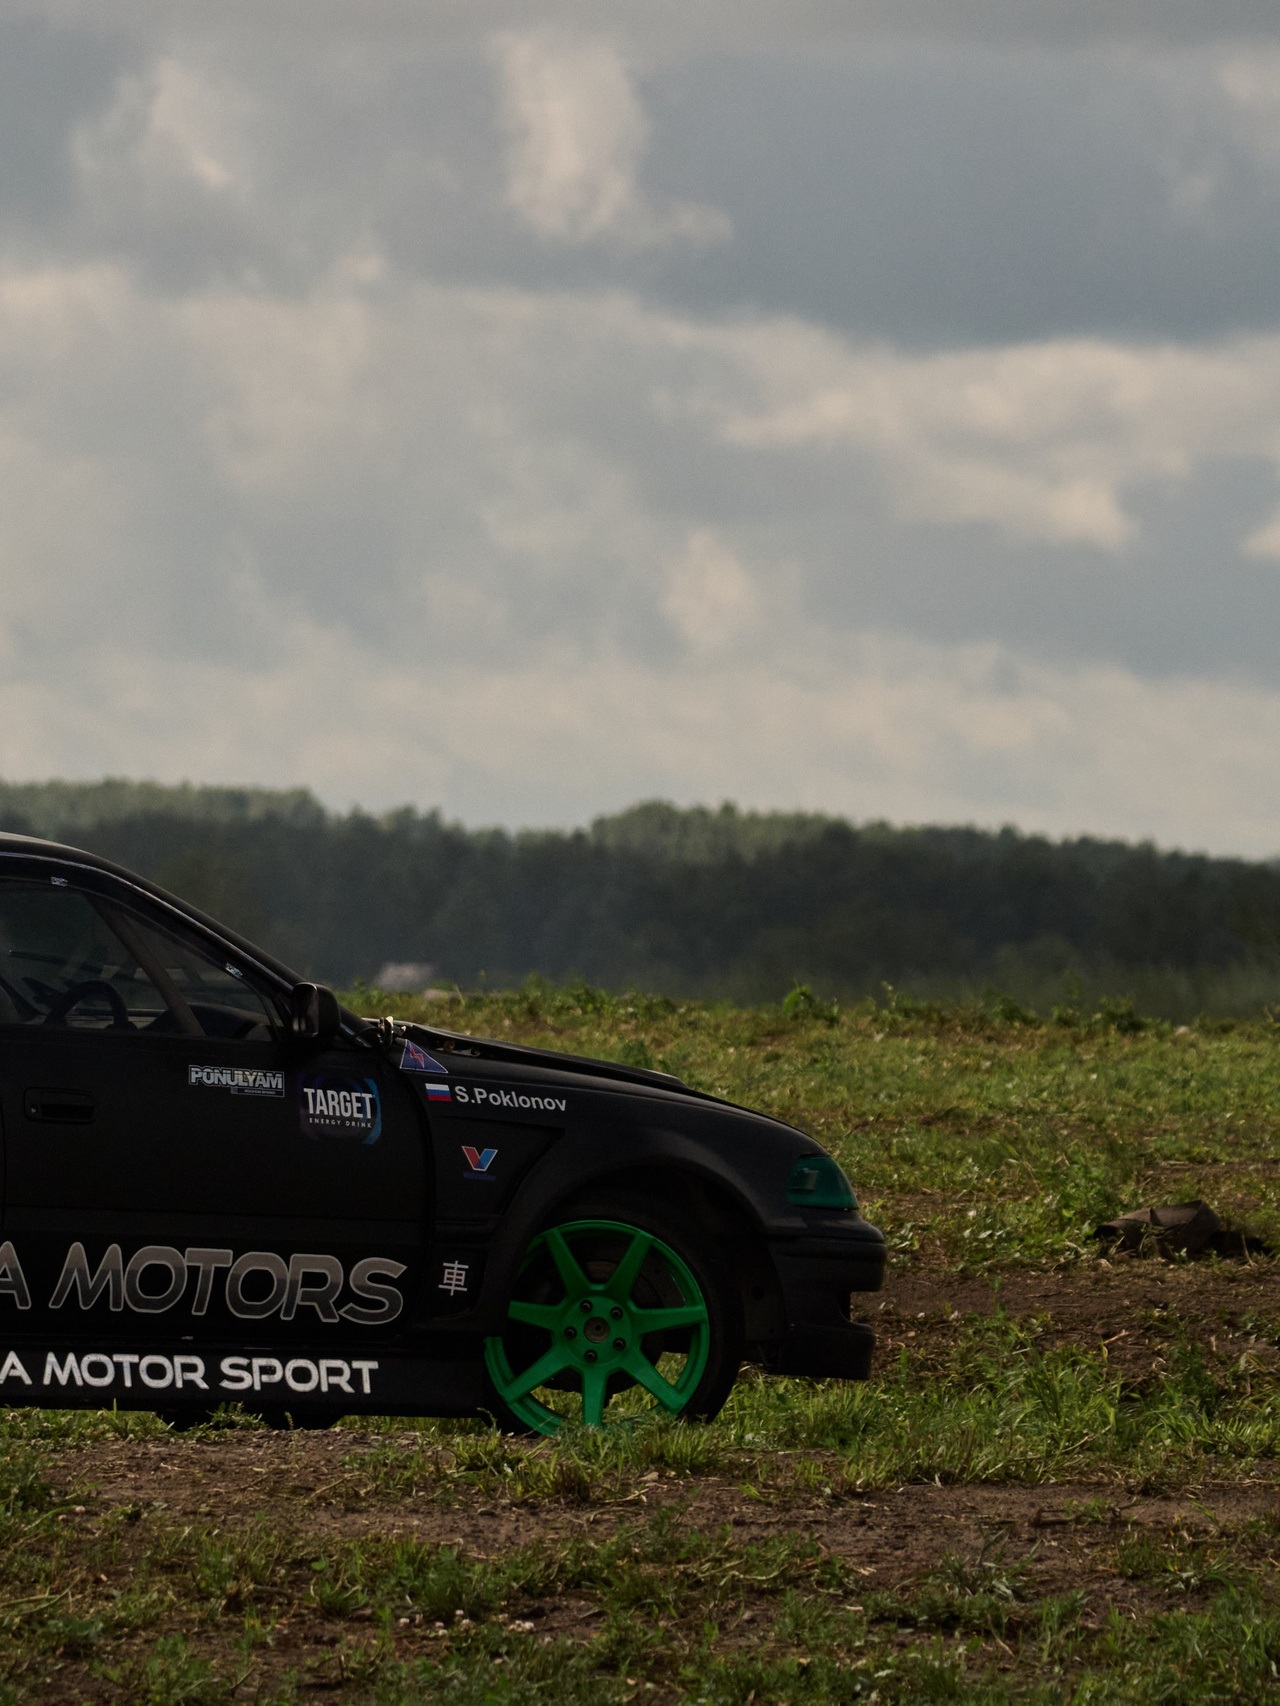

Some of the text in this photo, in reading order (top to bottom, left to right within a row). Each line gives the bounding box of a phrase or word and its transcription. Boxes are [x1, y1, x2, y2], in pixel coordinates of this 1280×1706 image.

[190, 1067, 283, 1089] PONULYAM
[303, 1088, 373, 1119] TARGET
[455, 1085, 567, 1111] S.Poklonov
[309, 1117, 372, 1128] ENERGY DRINK
[48, 1241, 408, 1325] MOTORS
[438, 1260, 469, 1296] 車
[43, 1351, 210, 1390] MOTOR
[218, 1355, 379, 1394] SPORT
